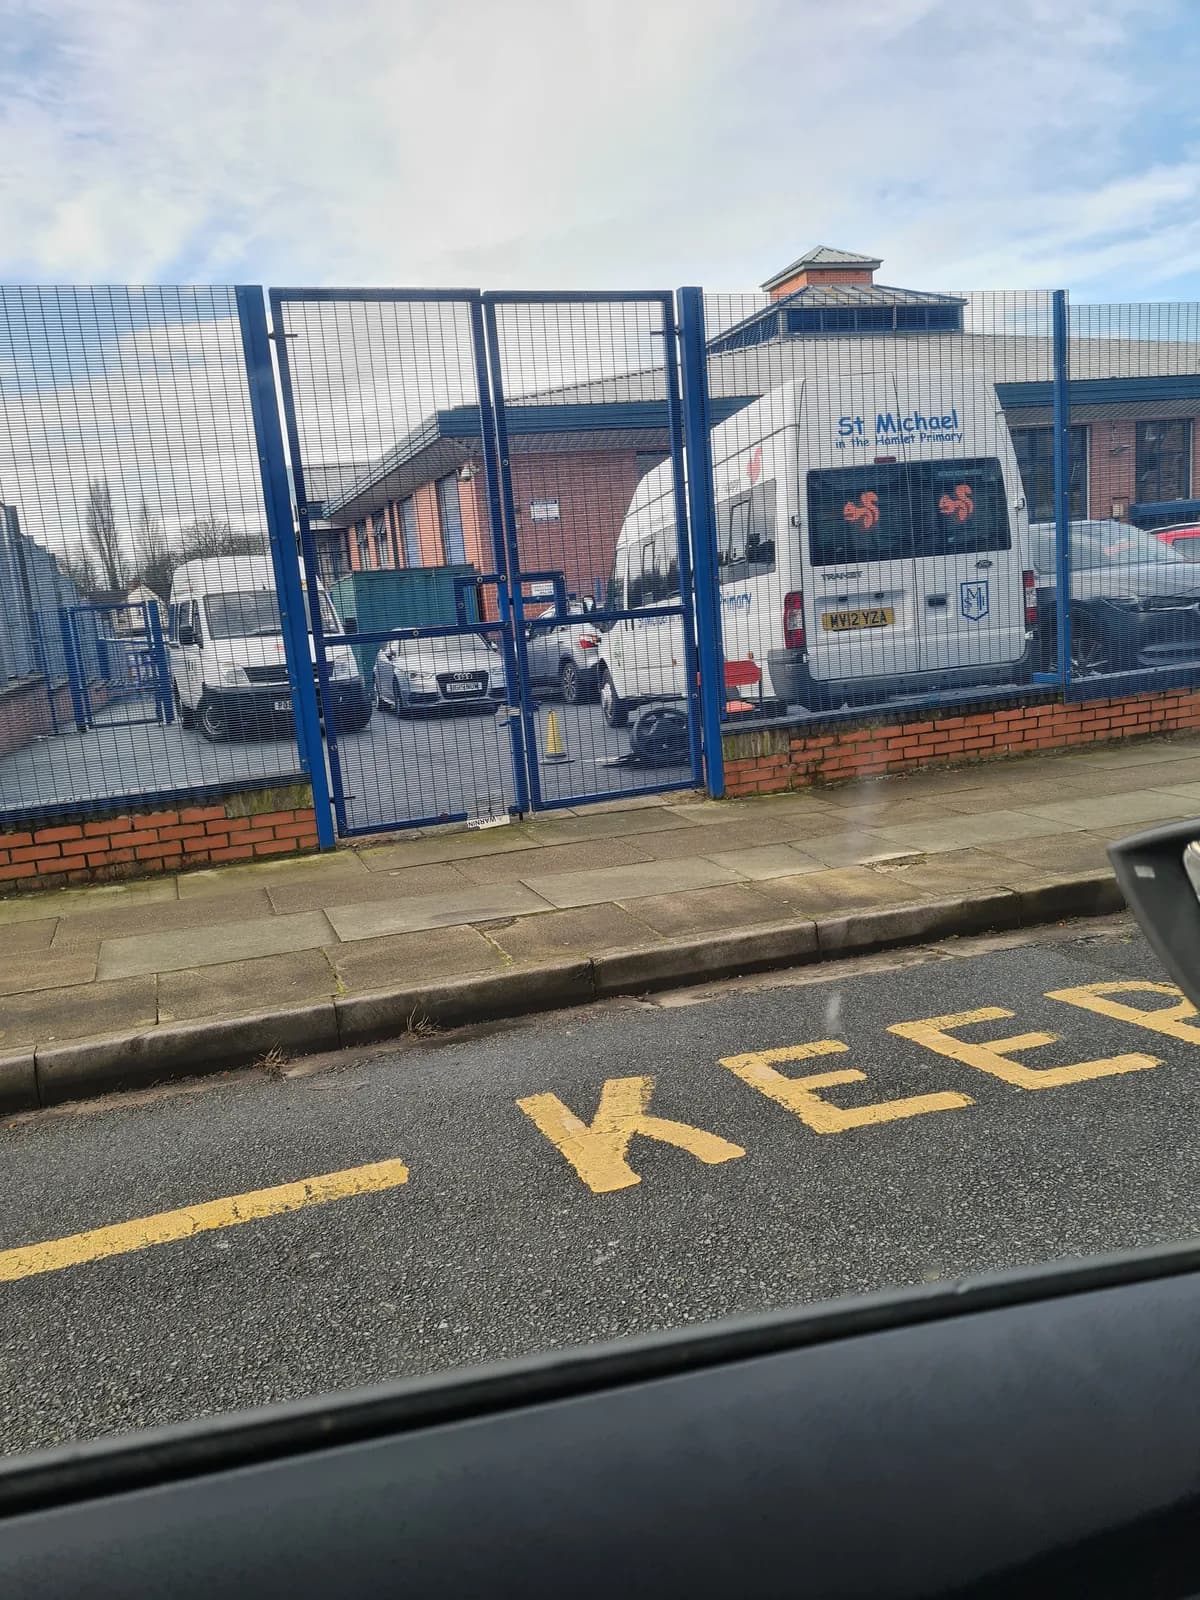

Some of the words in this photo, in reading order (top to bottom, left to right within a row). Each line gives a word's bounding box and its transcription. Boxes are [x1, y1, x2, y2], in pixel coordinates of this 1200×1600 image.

[838, 416, 864, 436] St
[876, 409, 958, 434] Michael
[835, 440, 845, 449] in
[851, 437, 870, 447] the
[876, 433, 915, 446] Hamlet
[920, 432, 962, 444] Primary
[863, 610, 888, 625] YZA
[515, 981, 1200, 1193] KEEP
